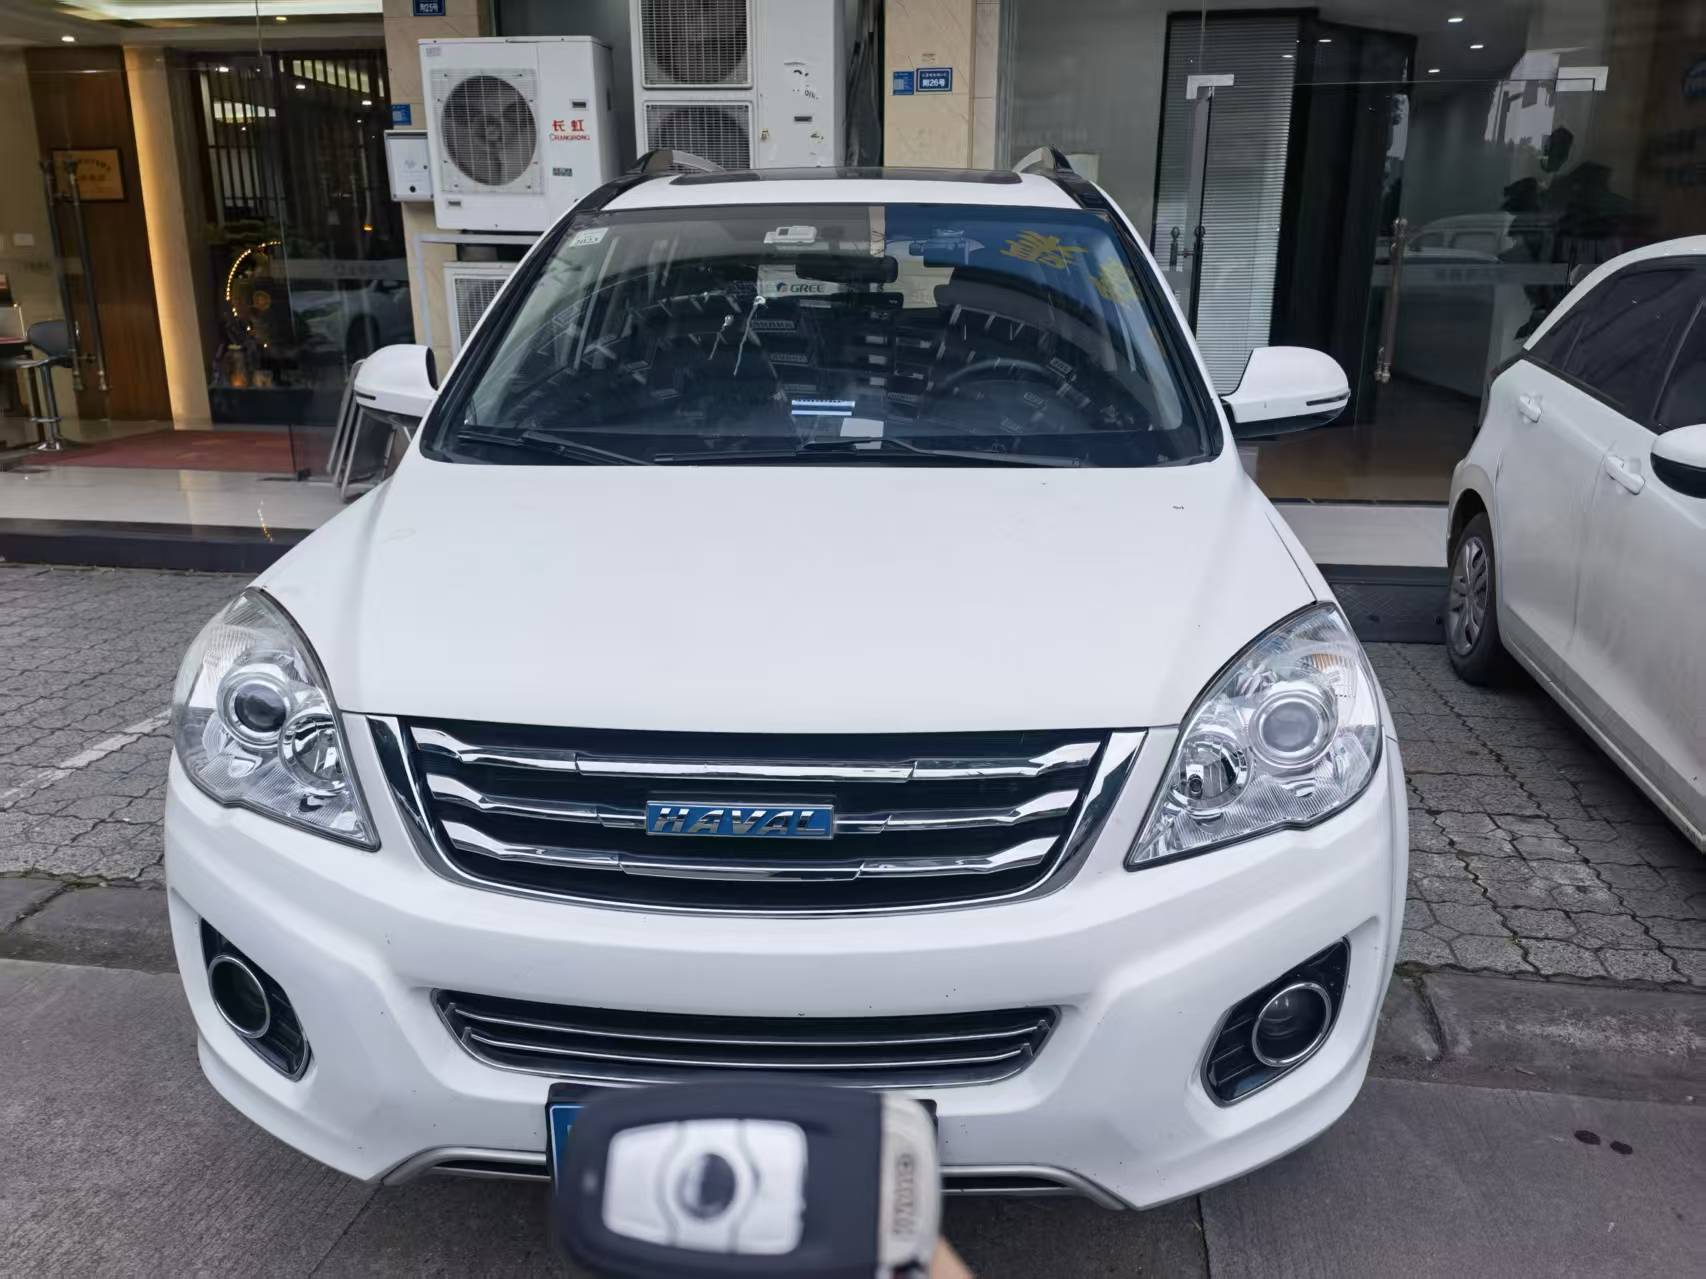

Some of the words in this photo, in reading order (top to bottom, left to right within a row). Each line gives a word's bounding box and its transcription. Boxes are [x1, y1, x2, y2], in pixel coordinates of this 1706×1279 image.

[552, 120, 585, 131] 长虹
[549, 132, 590, 141] CHANGHONG
[790, 284, 825, 293] GREE
[653, 807, 825, 835] HAVAL
